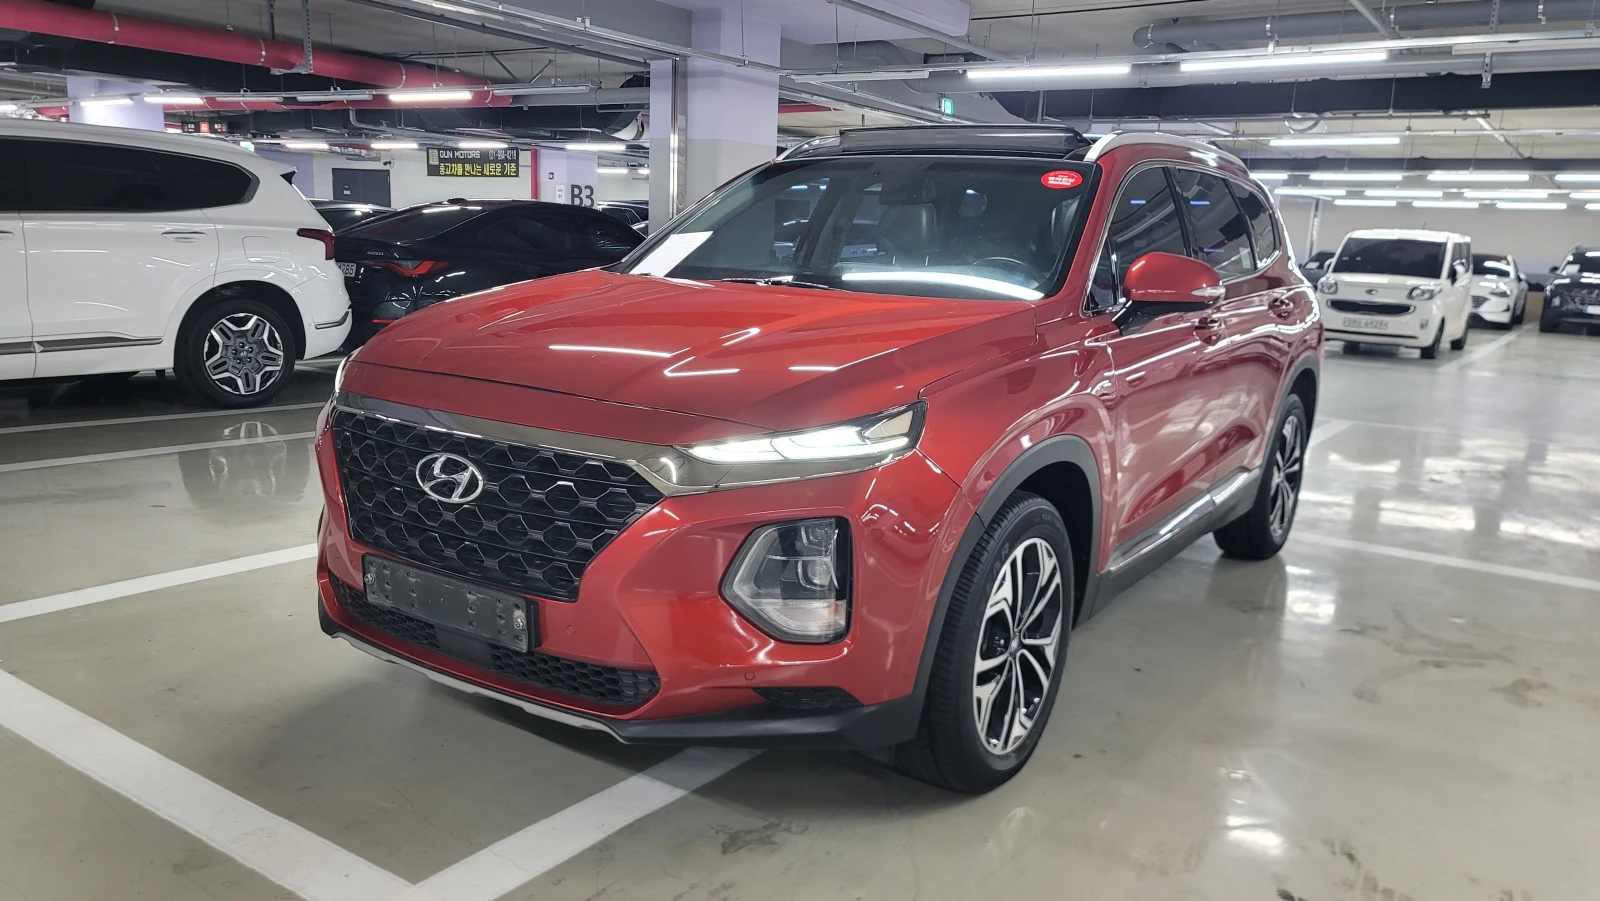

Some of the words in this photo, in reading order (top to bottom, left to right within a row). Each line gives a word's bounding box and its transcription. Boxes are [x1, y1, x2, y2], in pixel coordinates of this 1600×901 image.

[440, 151, 453, 159] GUN
[455, 151, 480, 159] MOTORS
[439, 163, 463, 175] 중고차를
[464, 163, 482, 176] 만나는
[483, 163, 502, 176] 새로운
[503, 163, 517, 176] 기준
[571, 184, 595, 208] B3
